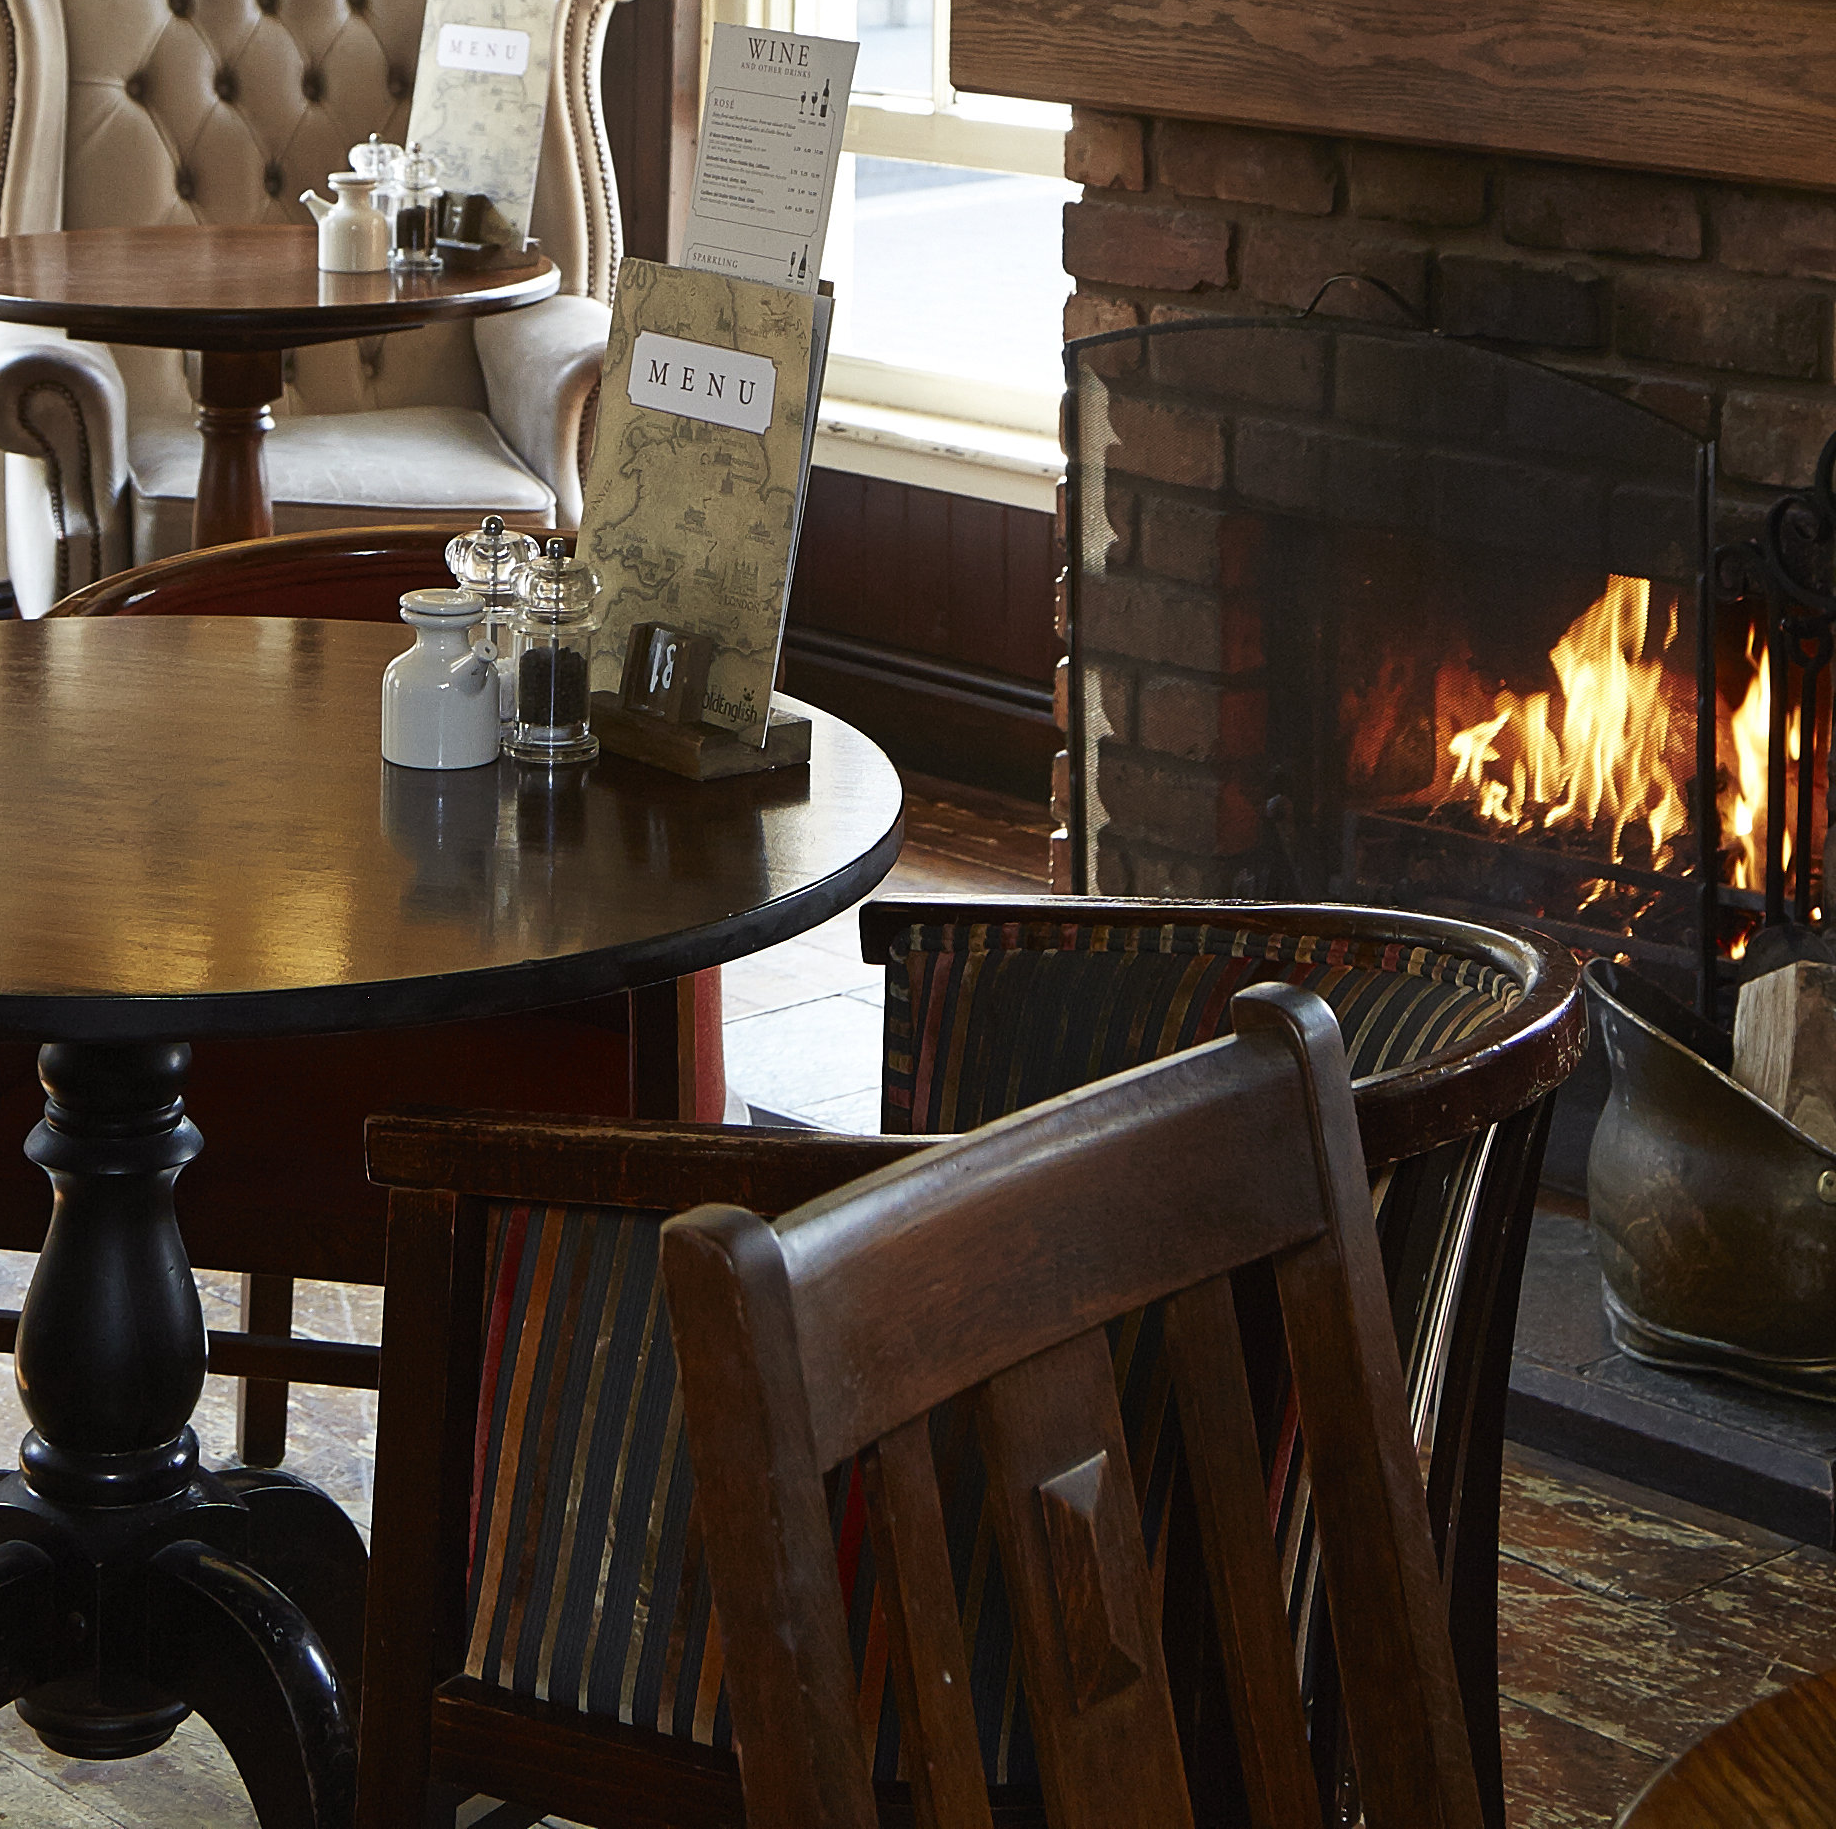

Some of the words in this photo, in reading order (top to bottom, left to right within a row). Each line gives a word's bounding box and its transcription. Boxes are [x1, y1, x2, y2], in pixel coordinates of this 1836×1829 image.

[450, 39, 517, 60] MENU
[748, 37, 810, 67] WINE
[740, 62, 756, 71] AND
[758, 64, 782, 76] OTHER
[784, 68, 812, 79] DRINKS
[692, 252, 739, 269] SPARKLING
[648, 359, 756, 405] MENU
